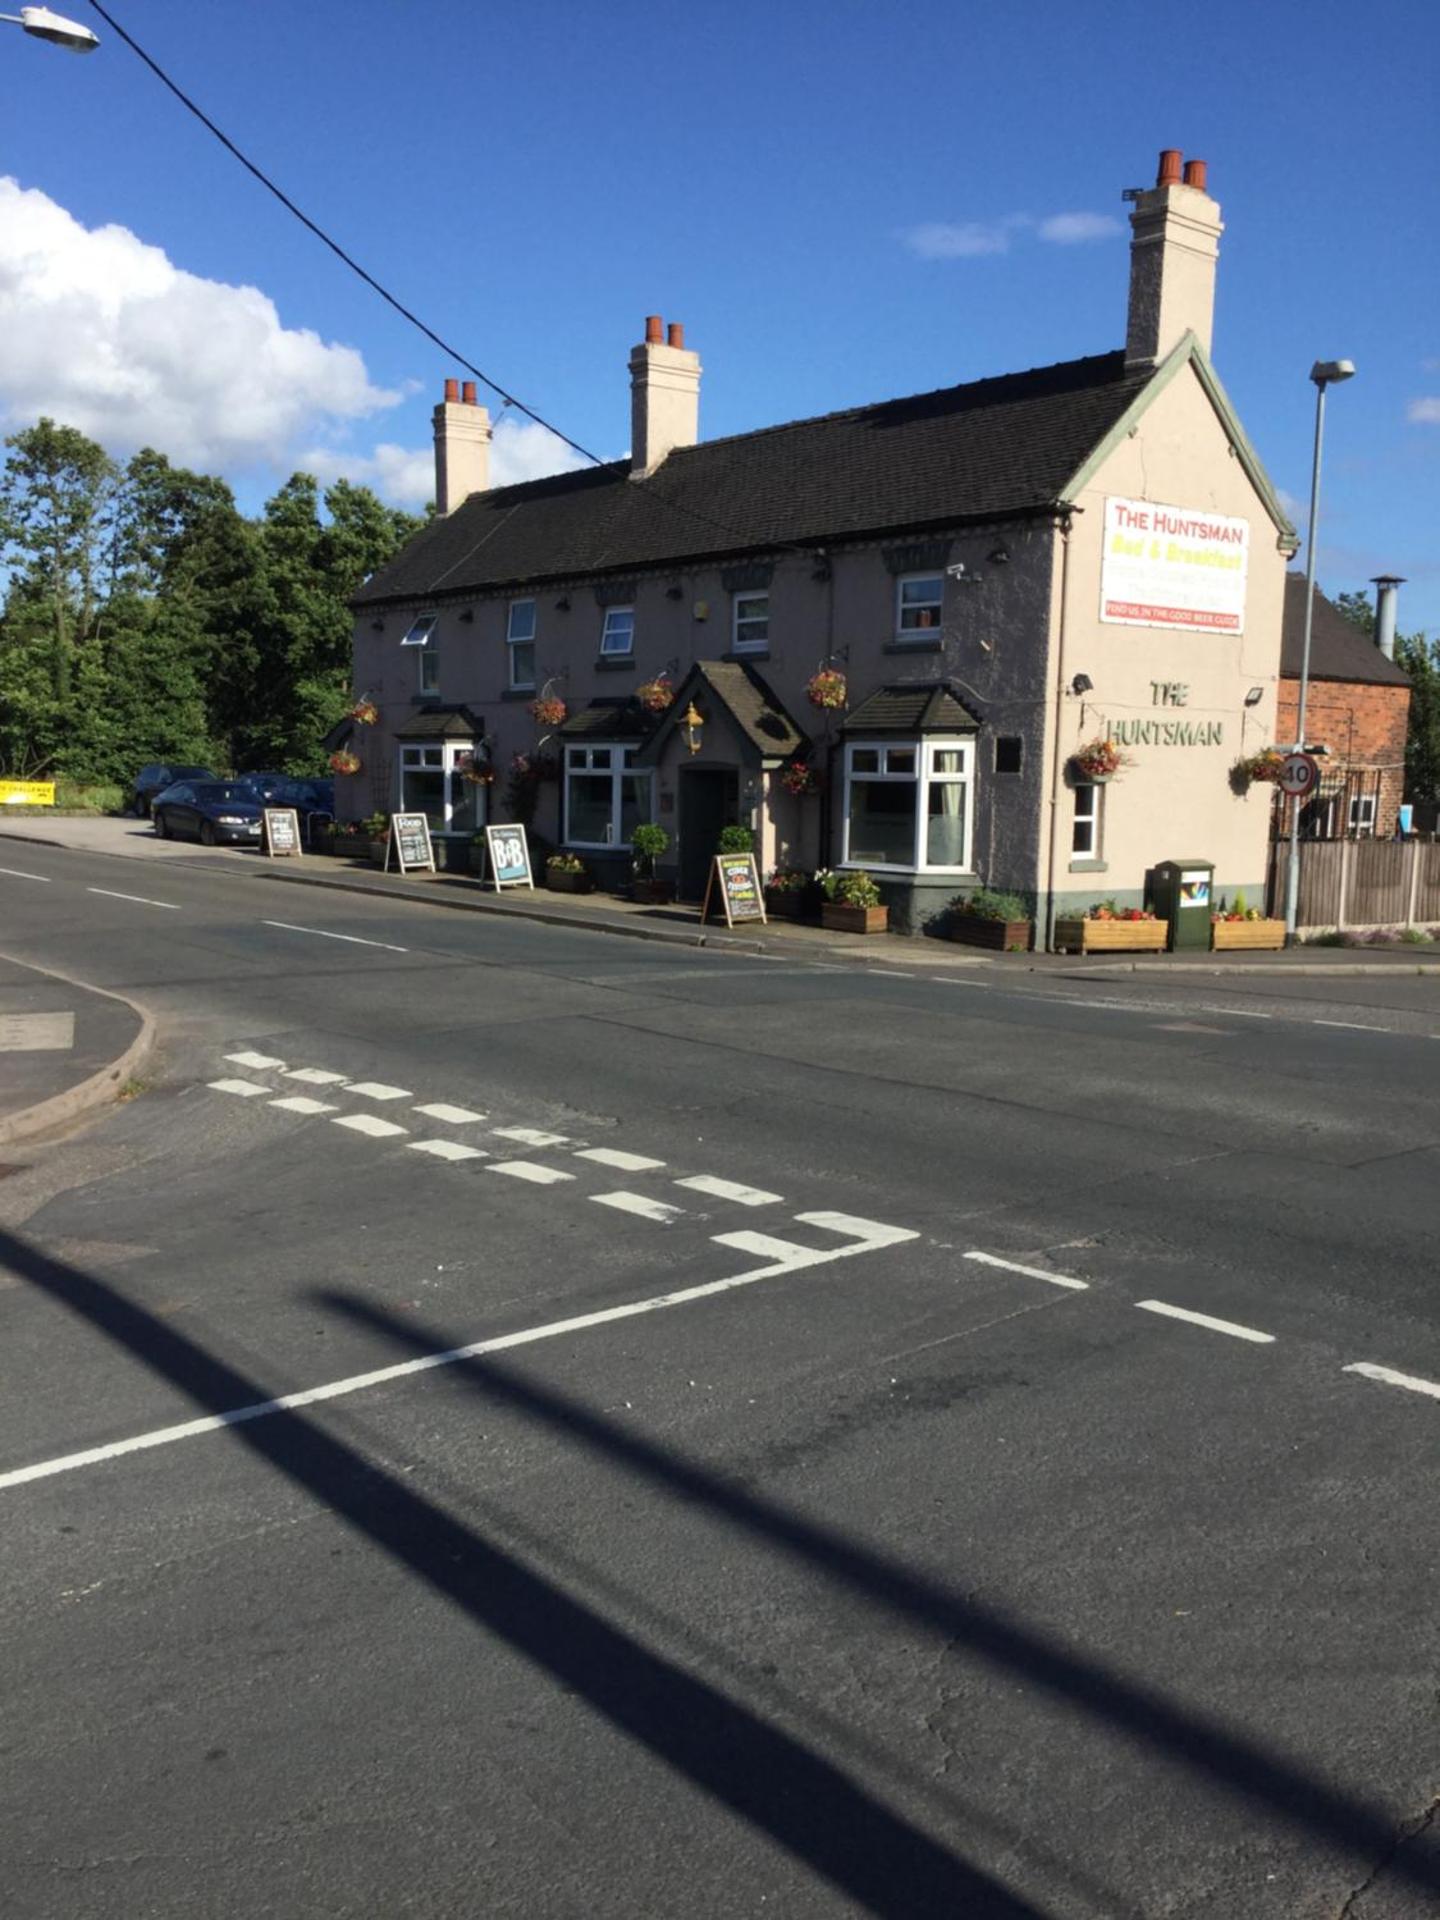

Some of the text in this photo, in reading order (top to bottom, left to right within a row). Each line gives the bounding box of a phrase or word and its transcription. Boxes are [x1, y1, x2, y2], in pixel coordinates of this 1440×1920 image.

[1153, 511, 1243, 544] HUNTSMAN
[1150, 680, 1189, 707] THE
[1107, 719, 1222, 746] HUNTSMAN
